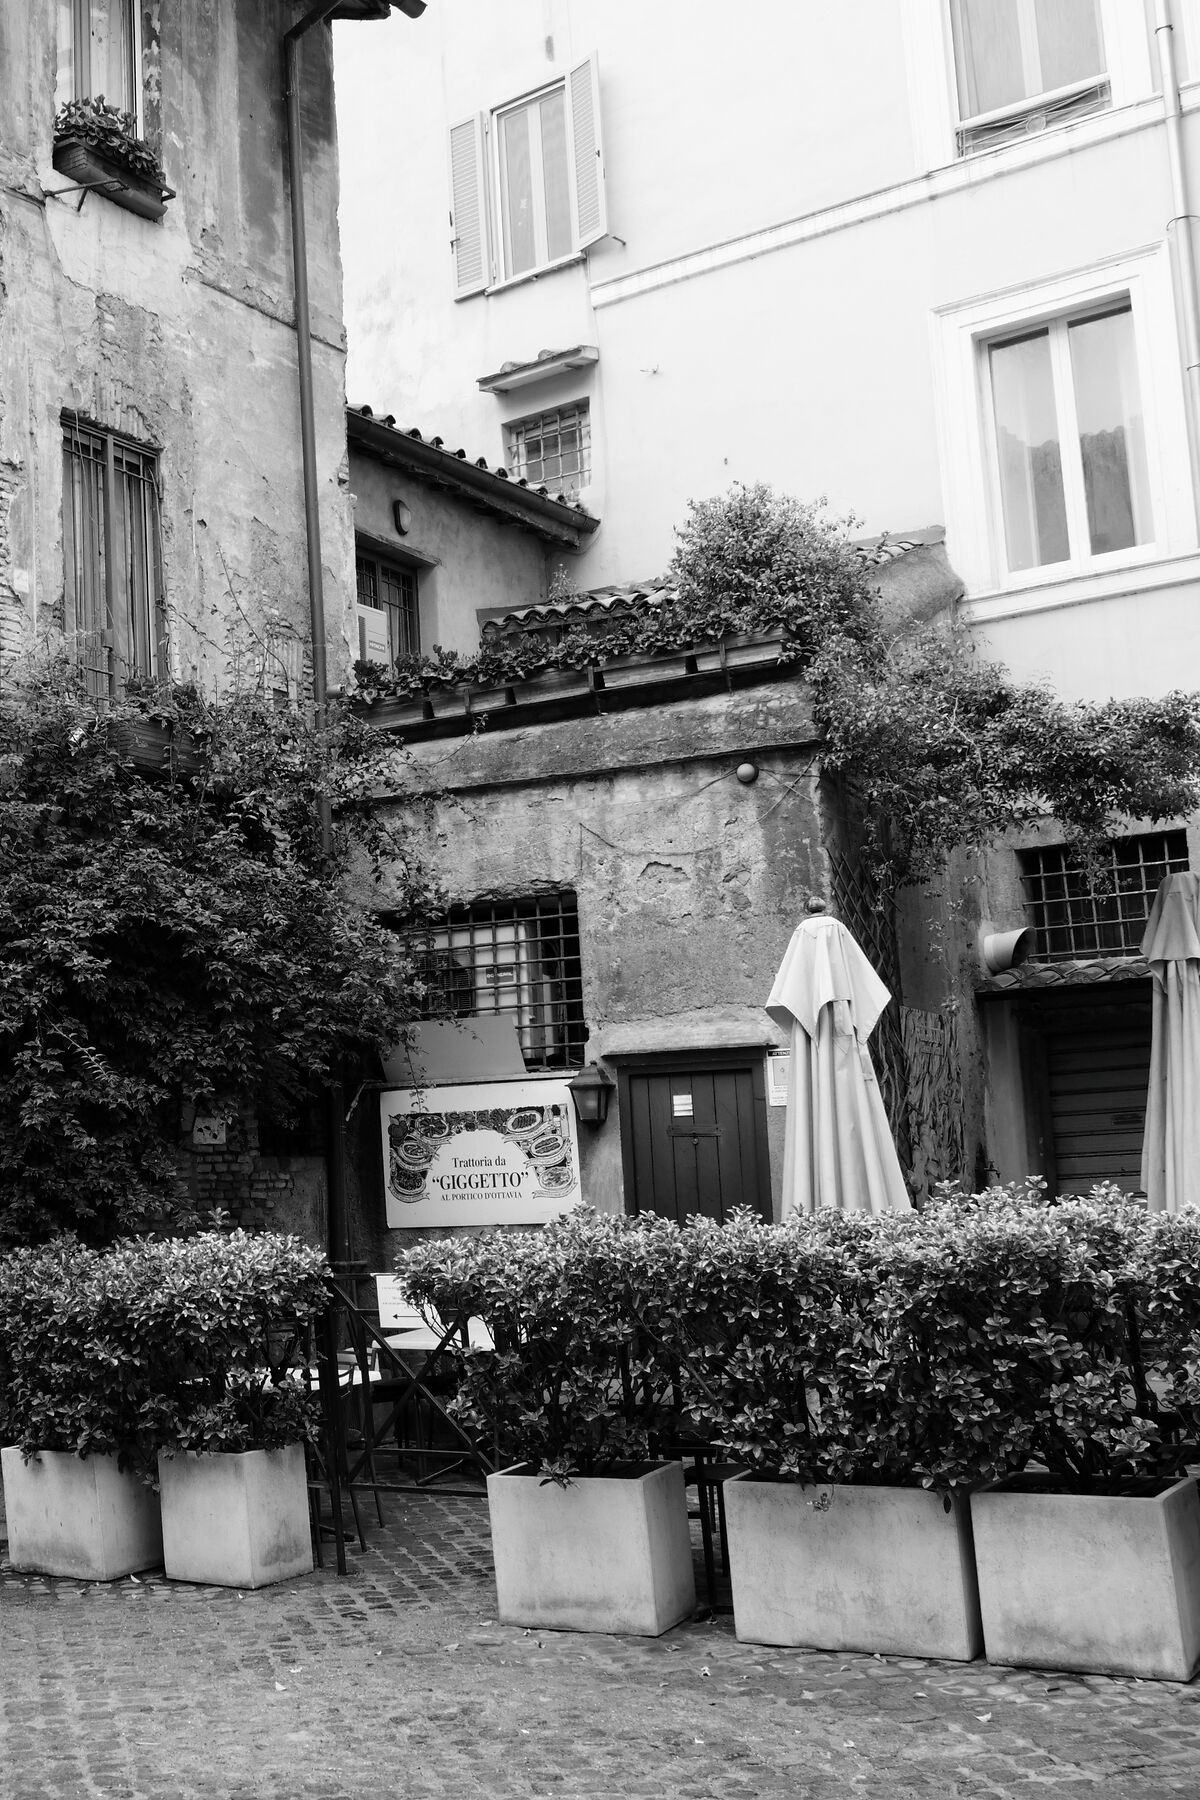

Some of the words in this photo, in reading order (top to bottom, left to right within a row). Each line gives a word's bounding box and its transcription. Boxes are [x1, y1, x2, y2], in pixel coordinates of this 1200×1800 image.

[451, 1156, 493, 1168] Trattoria
[494, 1155, 507, 1166] da
[452, 1192, 483, 1201] PORTICO
[484, 1191, 523, 1200] D'OTTAVIA
